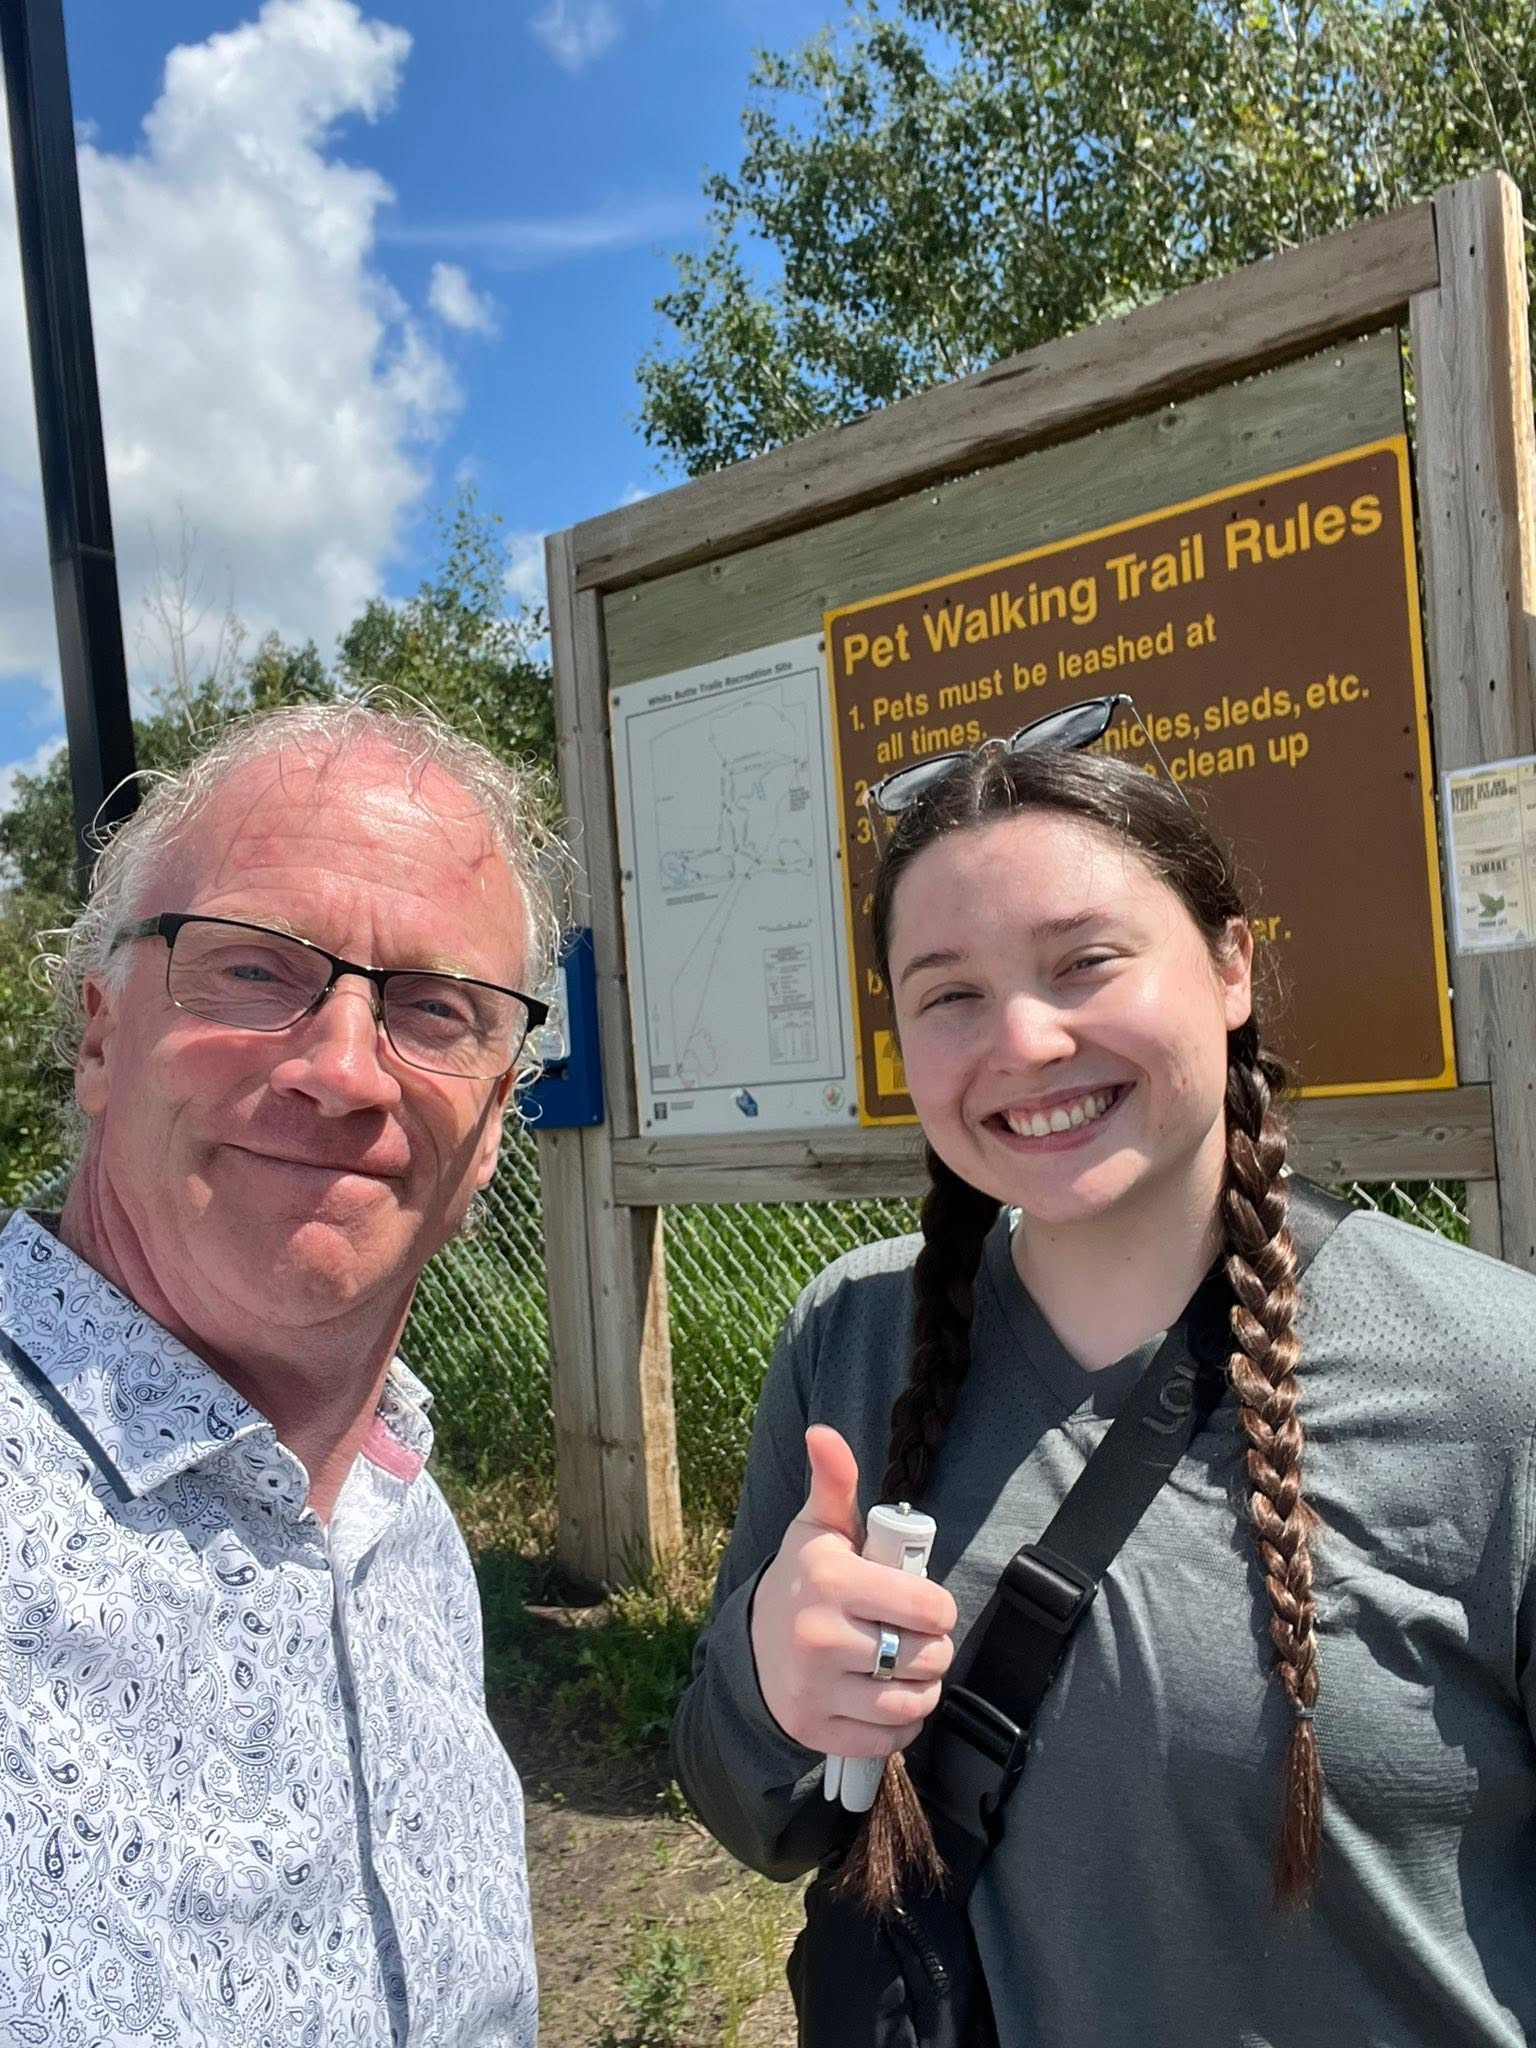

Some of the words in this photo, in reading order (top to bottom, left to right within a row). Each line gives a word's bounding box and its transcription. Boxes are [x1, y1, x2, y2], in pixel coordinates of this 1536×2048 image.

[843, 623, 911, 676] Pet
[922, 576, 1098, 653] Walking
[1105, 532, 1205, 601] Trail
[1225, 494, 1383, 572] Rules
[724, 667, 773, 686] Recreation
[849, 704, 866, 732] 1.
[873, 691, 930, 726] Pets
[938, 669, 1004, 710] must
[1012, 661, 1048, 693] be
[1057, 621, 1175, 681] leashed
[1186, 612, 1218, 649] at
[1203, 686, 1301, 733] sleds,
[1305, 672, 1371, 710] etc.
[876, 731, 904, 764] all
[911, 719, 988, 756] times.
[1169, 742, 1256, 783] clean
[1267, 731, 1310, 768] up
